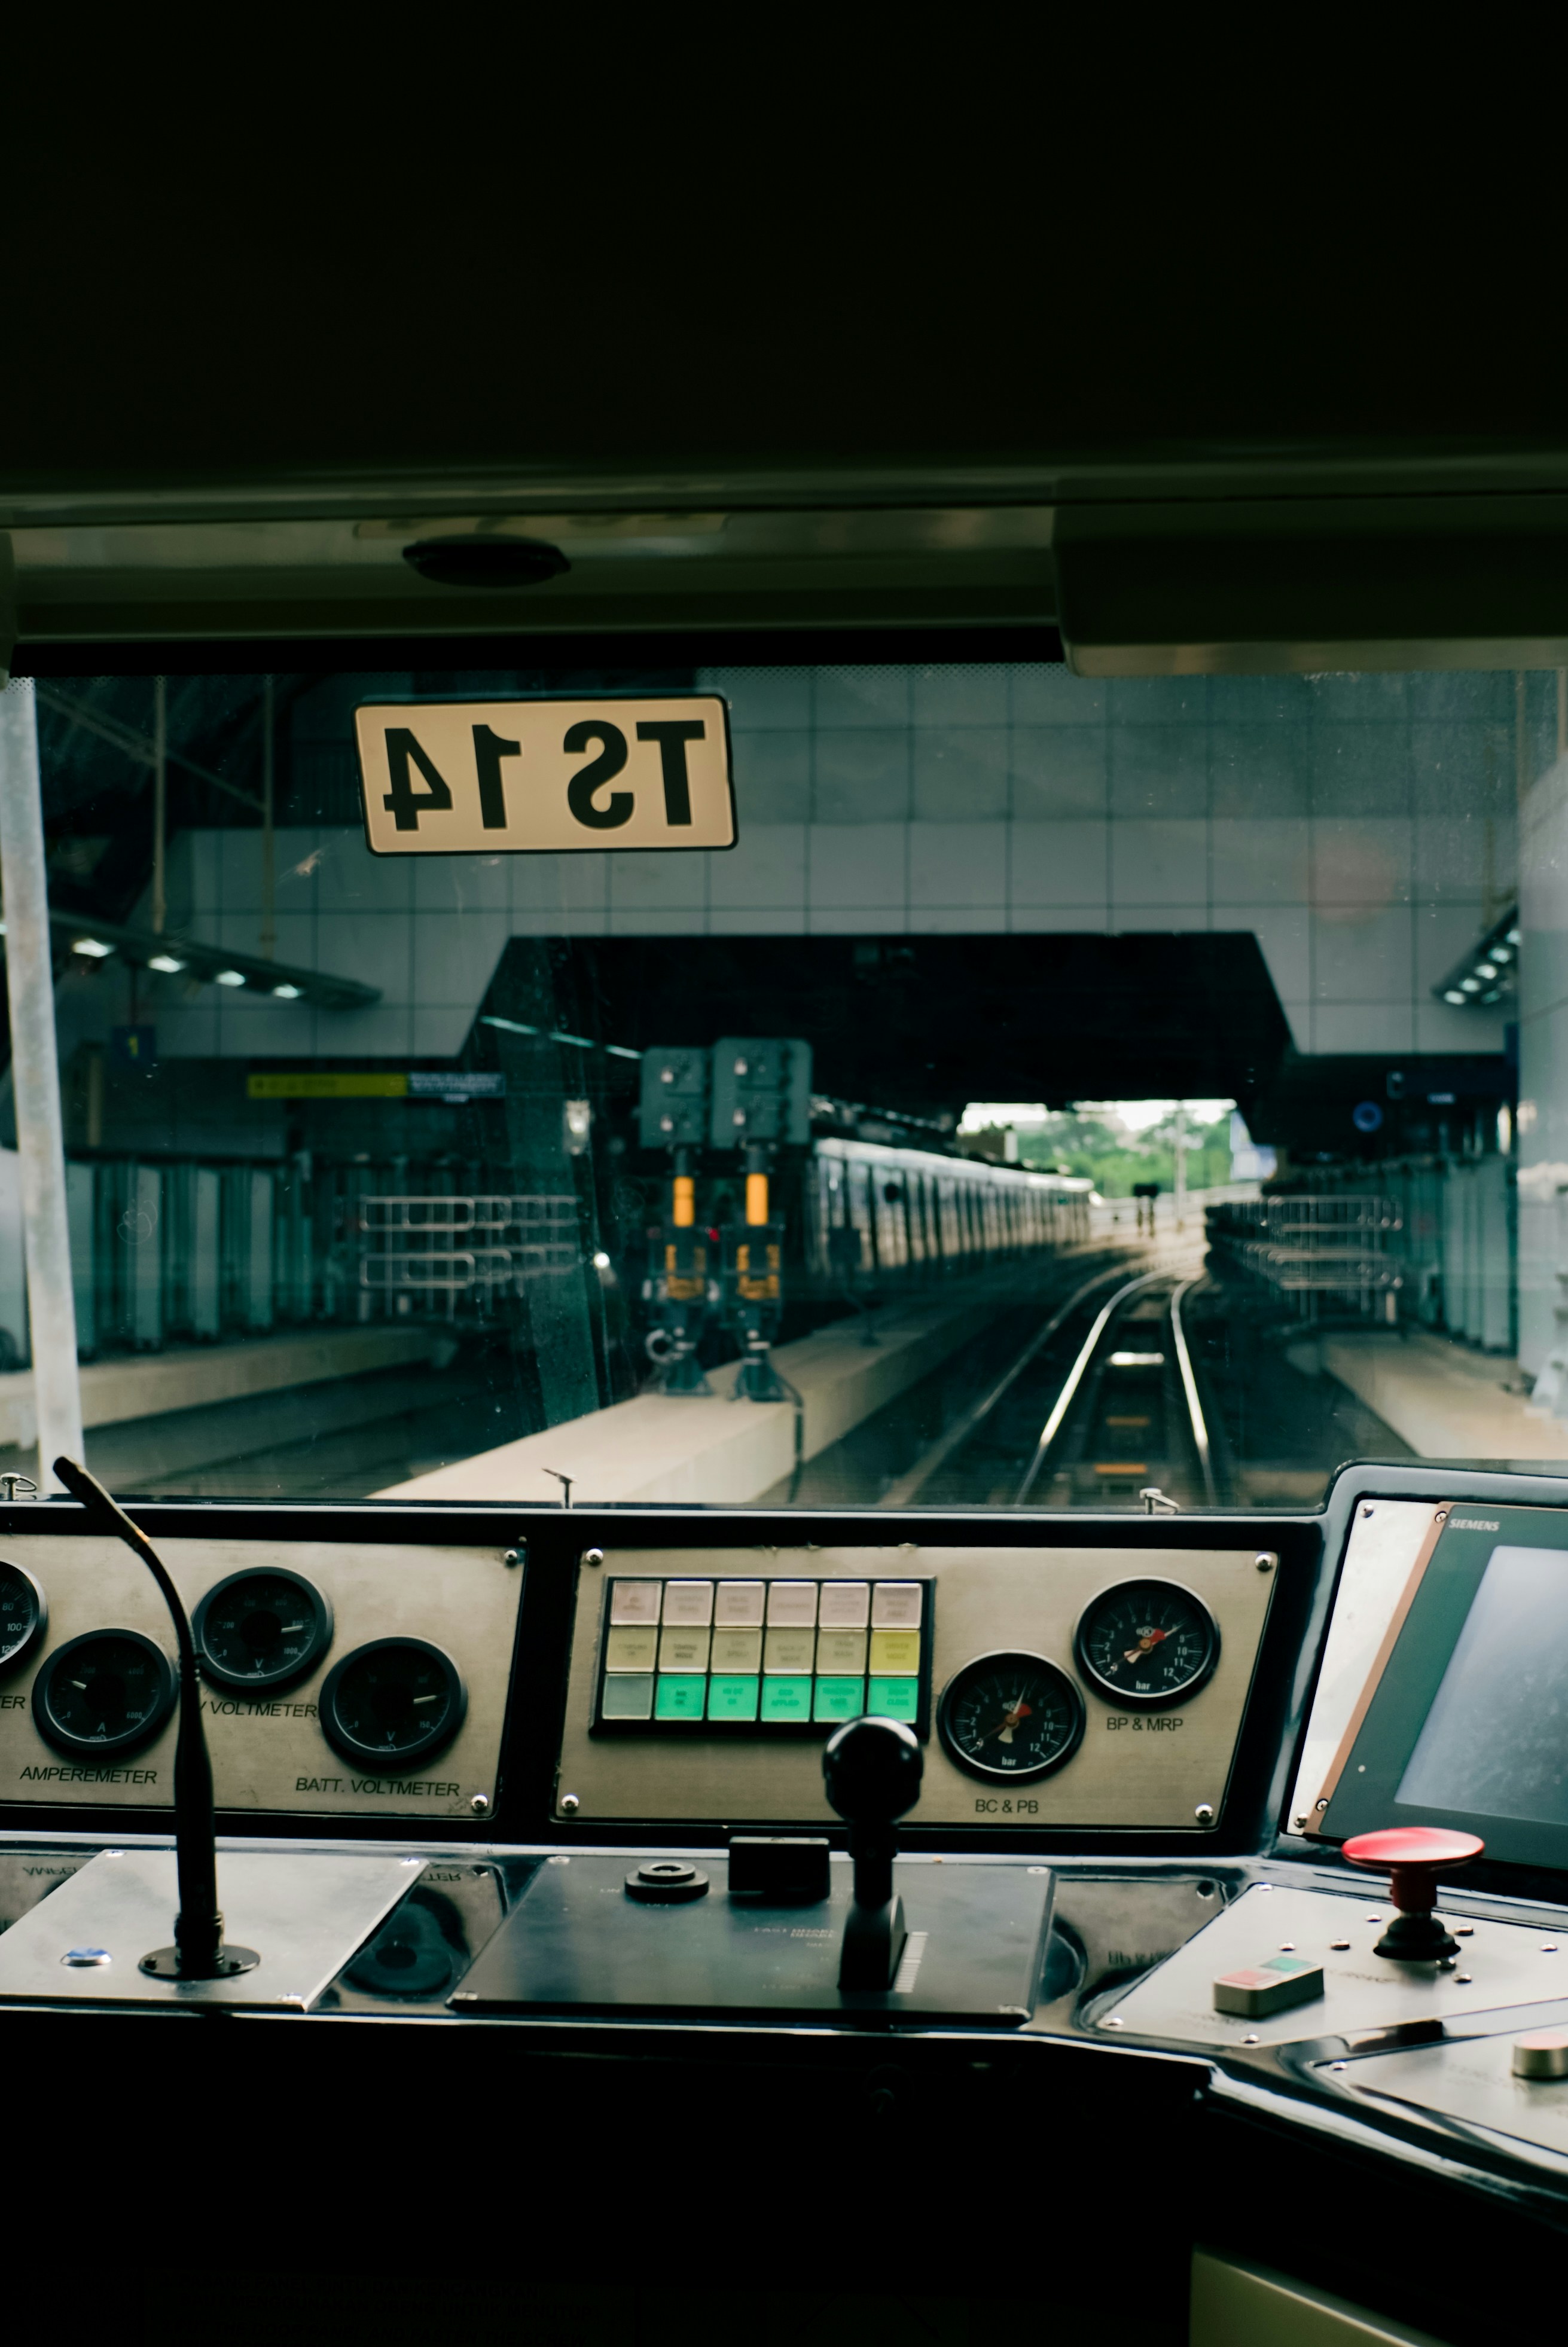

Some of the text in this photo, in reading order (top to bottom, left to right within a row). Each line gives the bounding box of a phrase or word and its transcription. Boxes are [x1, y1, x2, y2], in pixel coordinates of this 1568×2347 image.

[1448, 1518, 1500, 1531] SIEMENS
[2, 1603, 14, 1611] 80
[7, 1623, 22, 1631] 100
[1104, 1642, 1110, 1650] 2
[1177, 1646, 1187, 1656] 10
[255, 1658, 263, 1668] V
[1174, 1657, 1183, 1667] 11
[1163, 1667, 1174, 1677] 12
[1136, 1680, 1151, 1690] bar
[211, 1701, 318, 1718] VOLTMETER
[975, 1705, 981, 1714] 3
[1046, 1708, 1051, 1718] 9
[970, 1717, 977, 1726] 2
[1043, 1722, 1054, 1731] 10
[1107, 1717, 1183, 1731] BP & MRP
[97, 1722, 106, 1732] A
[386, 1731, 395, 1741] V
[1041, 1732, 1050, 1741] 11
[1030, 1742, 1041, 1752] 12
[1002, 1756, 1017, 1766] bar
[19, 1766, 158, 1784] AMPEREMETER
[295, 1777, 460, 1796] BATT. VOLTMETER
[975, 1799, 1038, 1814] BC & PB
